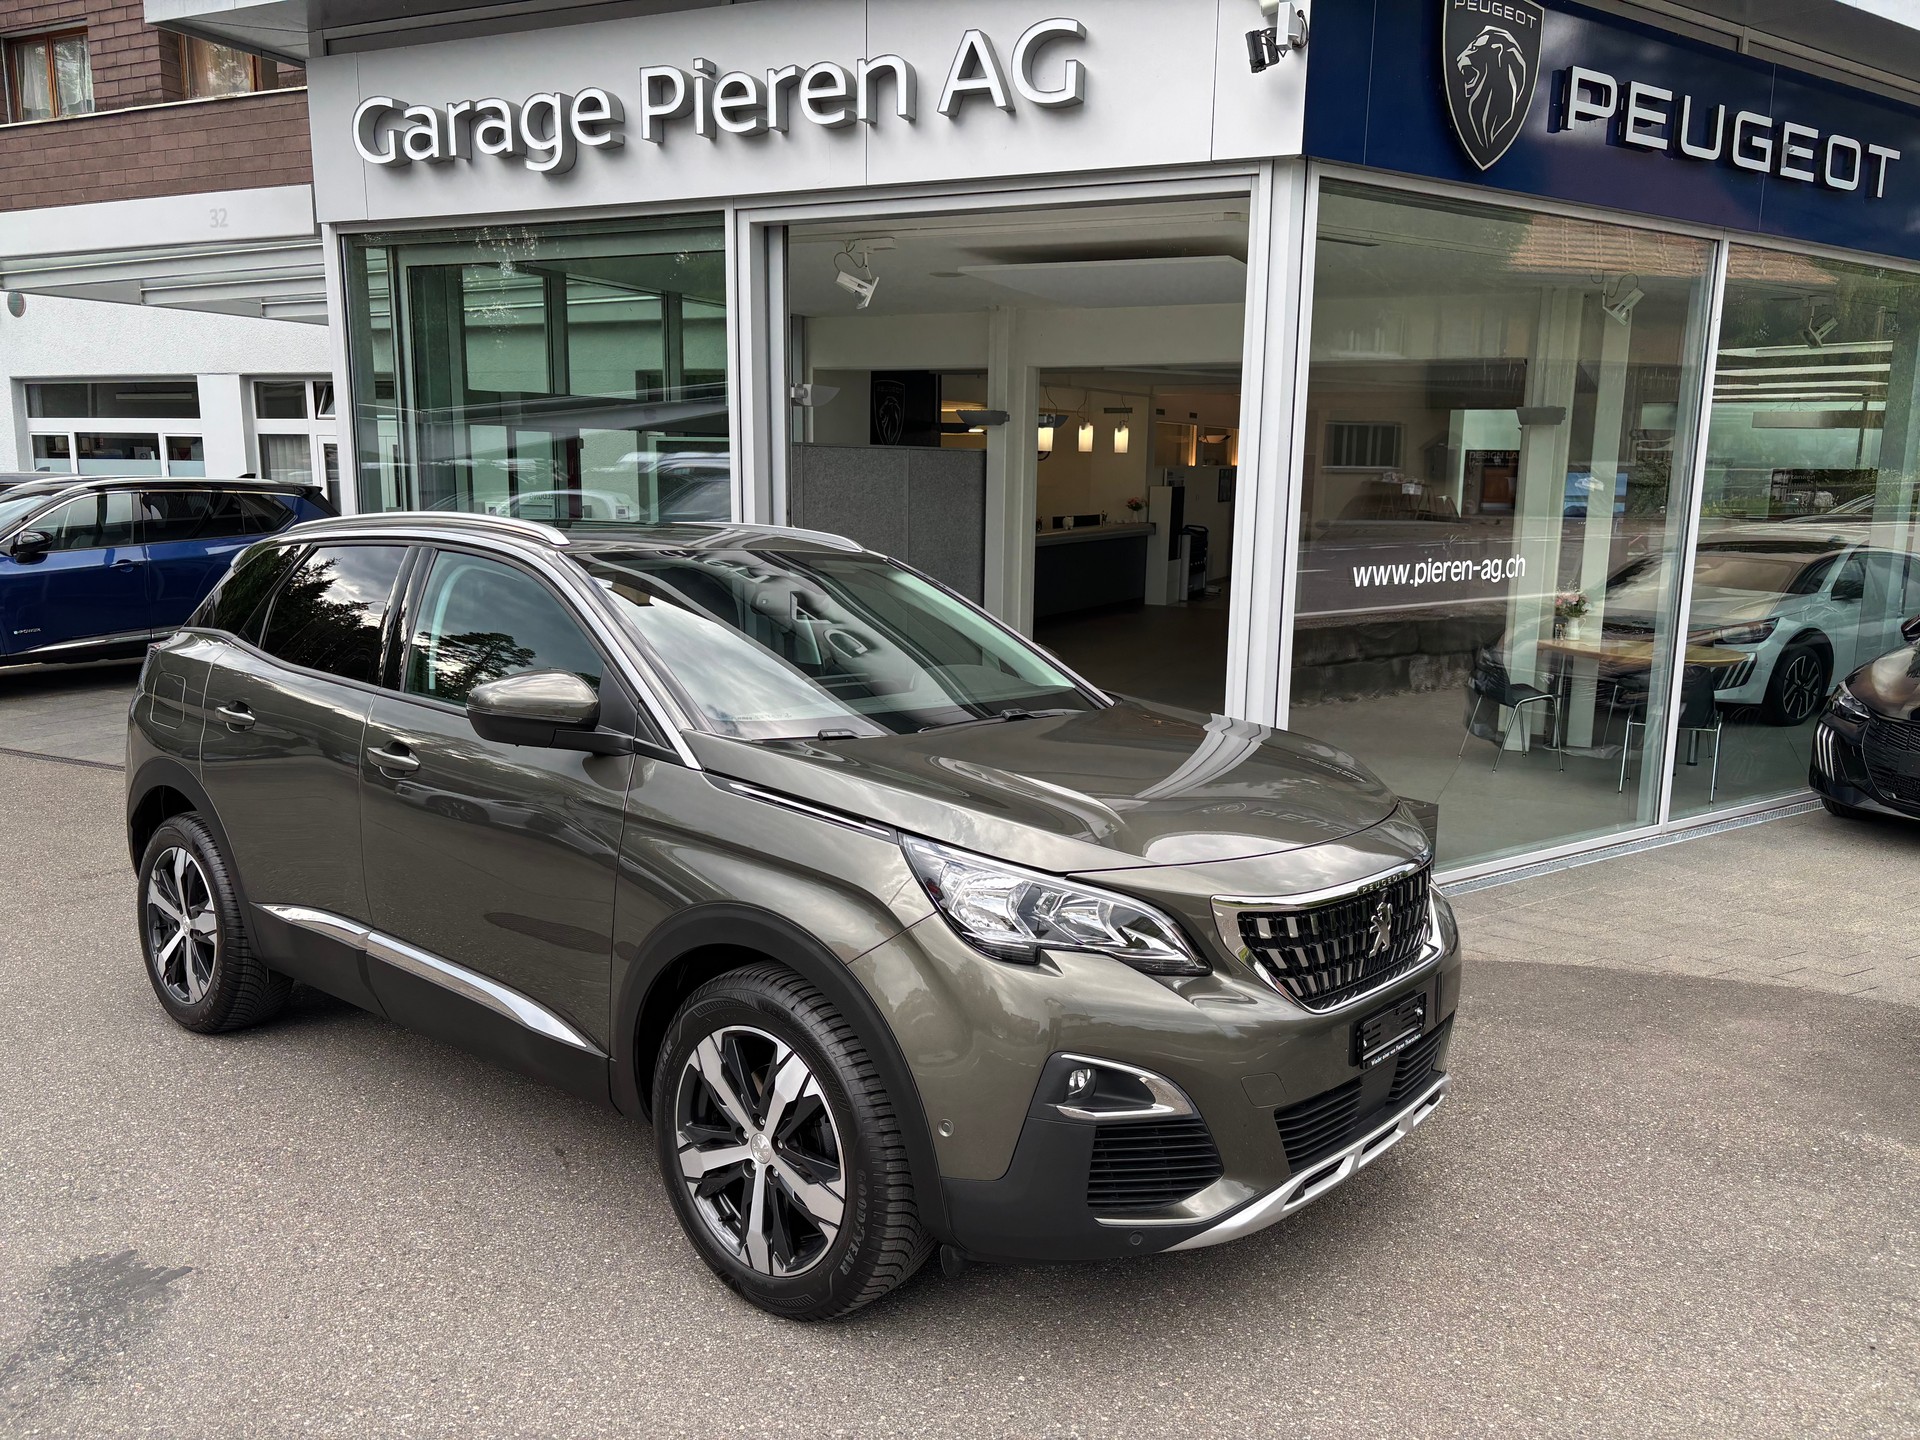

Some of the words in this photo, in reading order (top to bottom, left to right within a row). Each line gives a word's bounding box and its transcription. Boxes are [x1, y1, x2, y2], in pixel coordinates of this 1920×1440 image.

[1454, 0, 1537, 29] PEUGEOT
[352, 86, 624, 175] Garage
[639, 53, 917, 144] Pieren
[936, 17, 1086, 118] AG
[1564, 65, 1902, 198] PEUGEOT
[209, 207, 229, 228] 32
[1352, 554, 1526, 588] www.pieren-ag.ch
[1362, 873, 1403, 894] PEUGEOT
[839, 1168, 868, 1276] GOODYEAR
